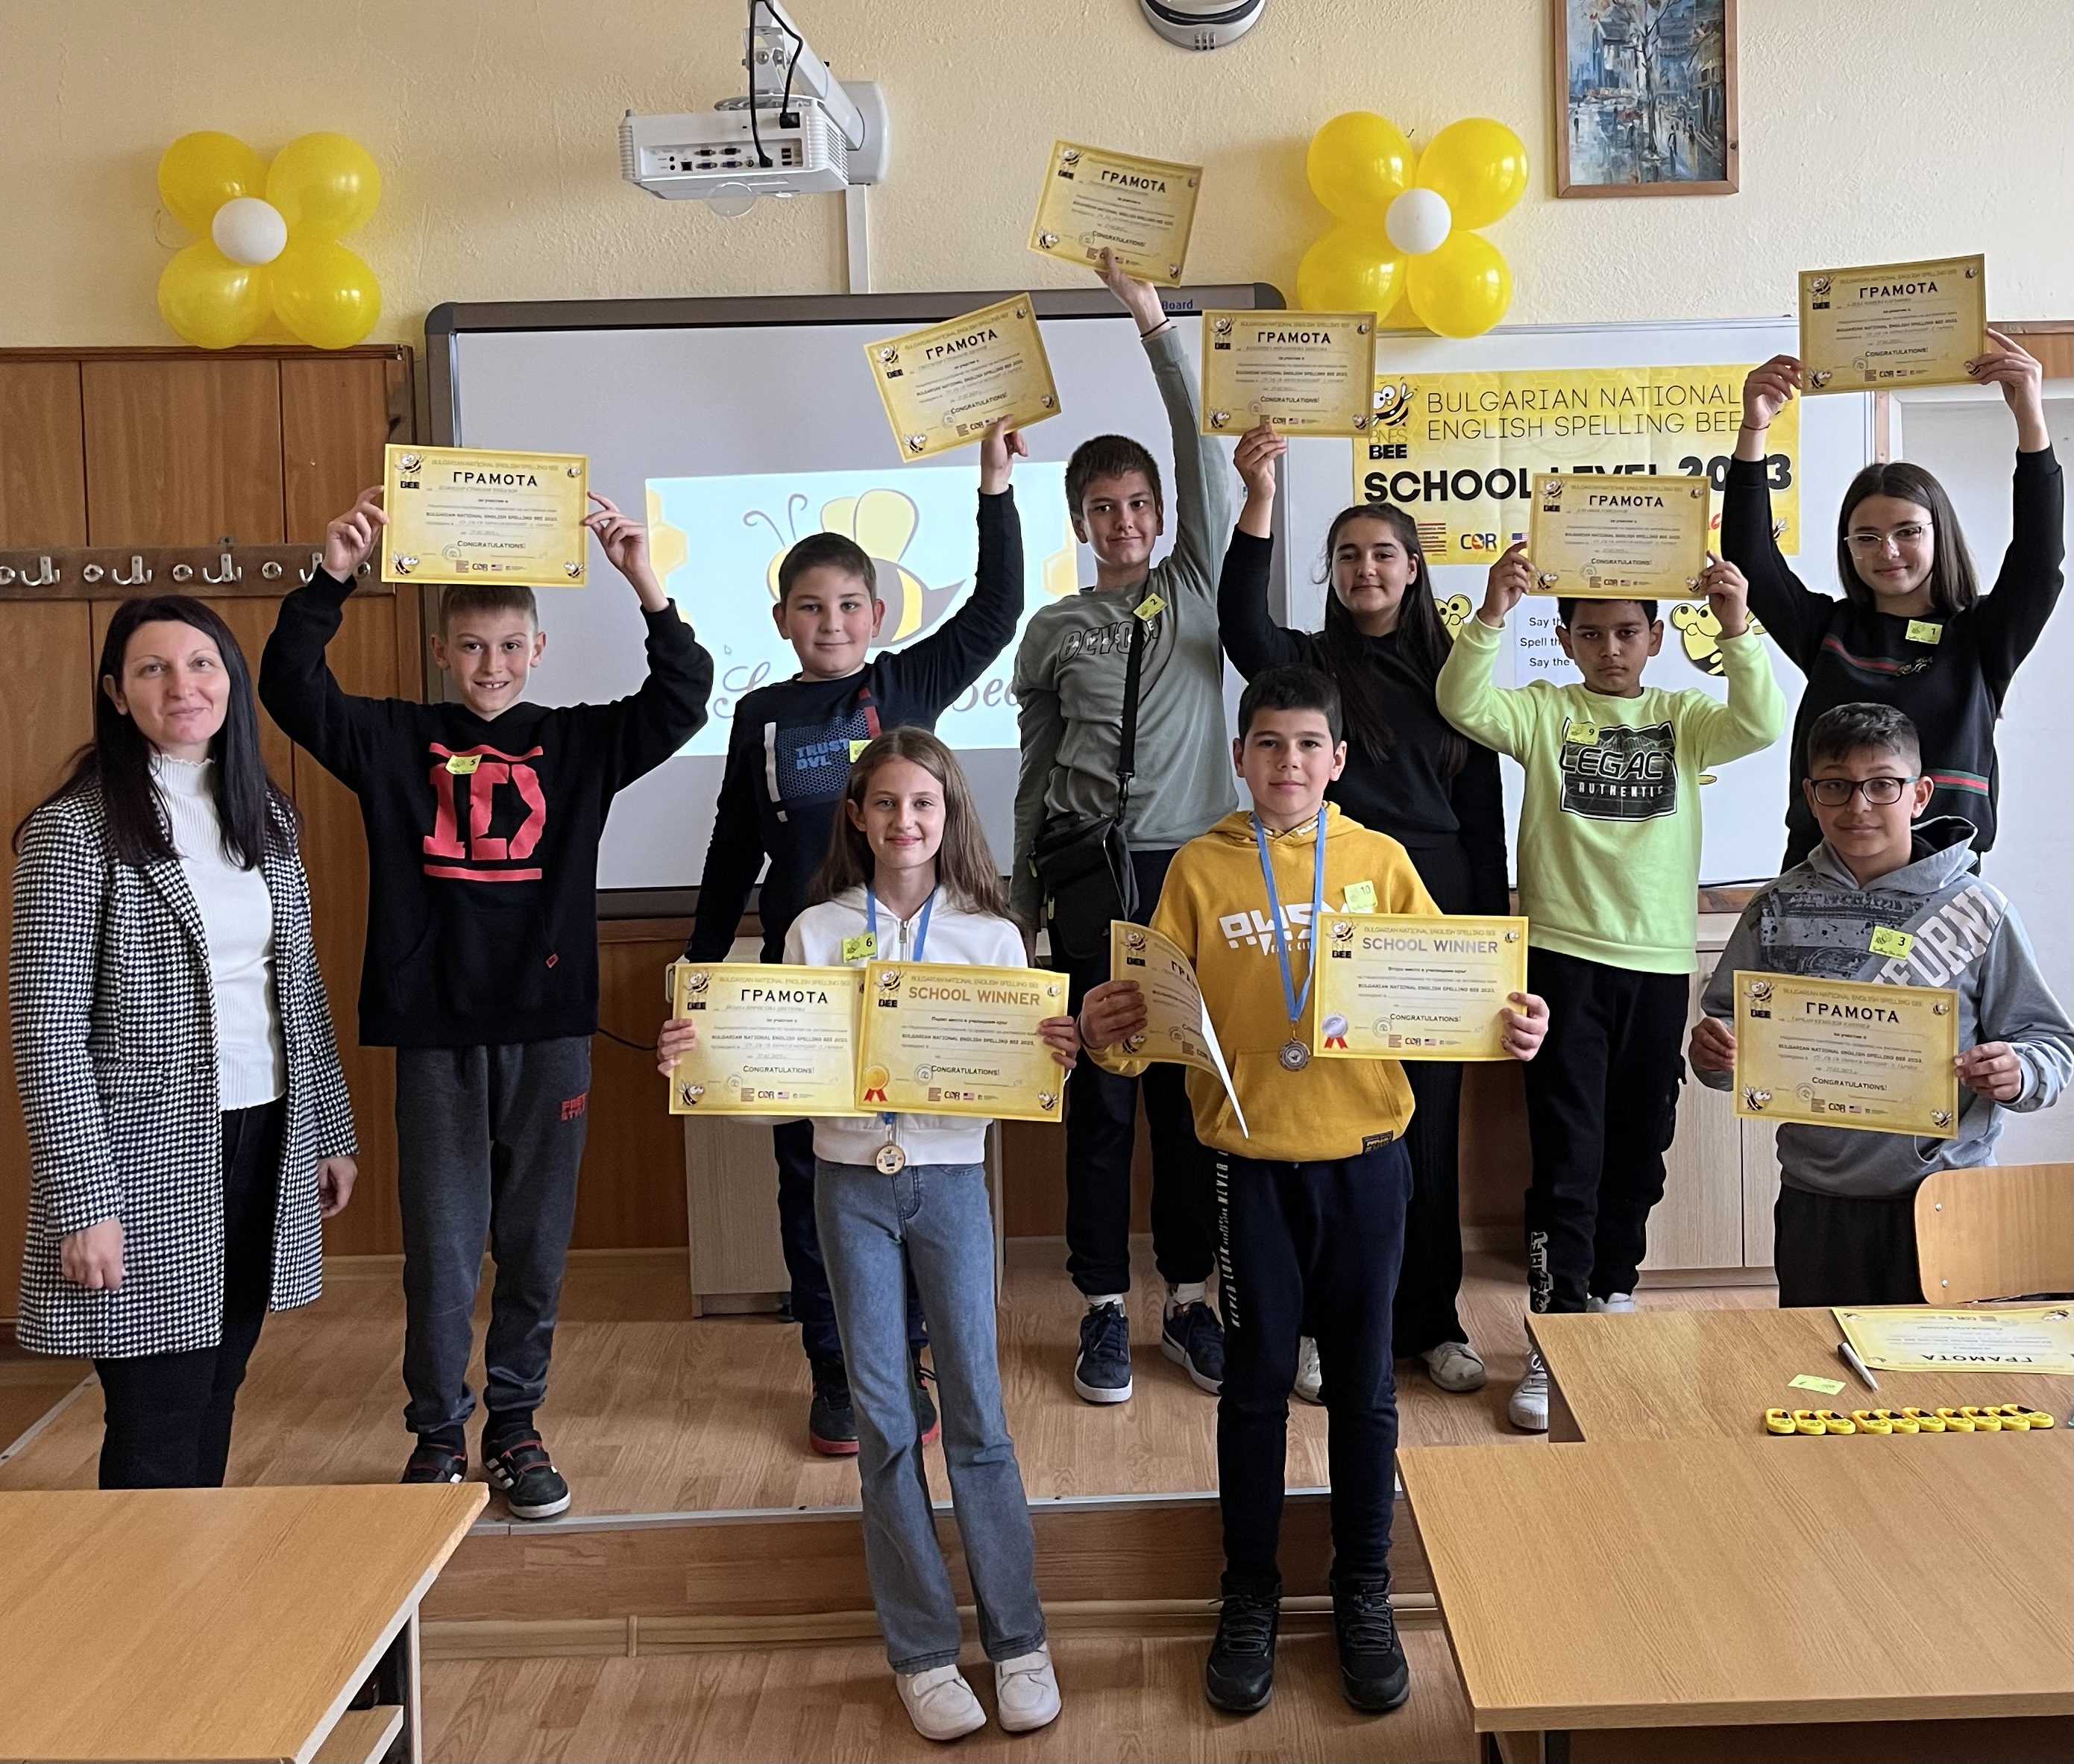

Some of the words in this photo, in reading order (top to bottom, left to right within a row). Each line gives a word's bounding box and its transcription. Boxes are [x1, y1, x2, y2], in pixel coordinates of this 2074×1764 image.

[1100, 169, 1167, 193] ГРАМОТА
[1859, 280, 1938, 299] ГРАМОТА
[925, 327, 998, 360] ГРАМОТА
[1257, 331, 1331, 344] ГРАМОТА
[1427, 388, 1588, 413] BULGARIAN
[1600, 385, 1741, 409] NATIONAL
[1427, 418, 1543, 441] ENGLISH
[1554, 412, 1684, 439] SPELLING
[1696, 410, 1744, 433] BEE
[1368, 444, 1408, 459] BEE
[453, 471, 538, 487] ГРАМОТА
[1364, 469, 1533, 503] SCHOOL
[1589, 495, 1664, 507] ГРАМОТА
[1529, 618, 1549, 628] Say
[1553, 618, 1565, 626] th
[1520, 638, 1547, 648] Spell
[1551, 638, 1561, 646] th
[1530, 658, 1549, 668] Say
[1553, 658, 1570, 666] the
[1589, 728, 1595, 736] 9
[796, 738, 850, 758] TRUST
[1579, 782, 1664, 797] AUTHENTIC
[1360, 885, 1371, 895] 10
[865, 937, 873, 947] 6
[1362, 937, 1427, 951] SCHOOL
[1433, 939, 1498, 953] WINNER
[1897, 936, 1906, 947] 3
[741, 988, 829, 1003] ГРАМОТА
[908, 985, 971, 1001] SCHOOL
[976, 989, 1040, 1005] WINNER
[1806, 1002, 1899, 1023] ГРАМОТА
[1920, 1354, 2033, 1363] ГРАМОТА
